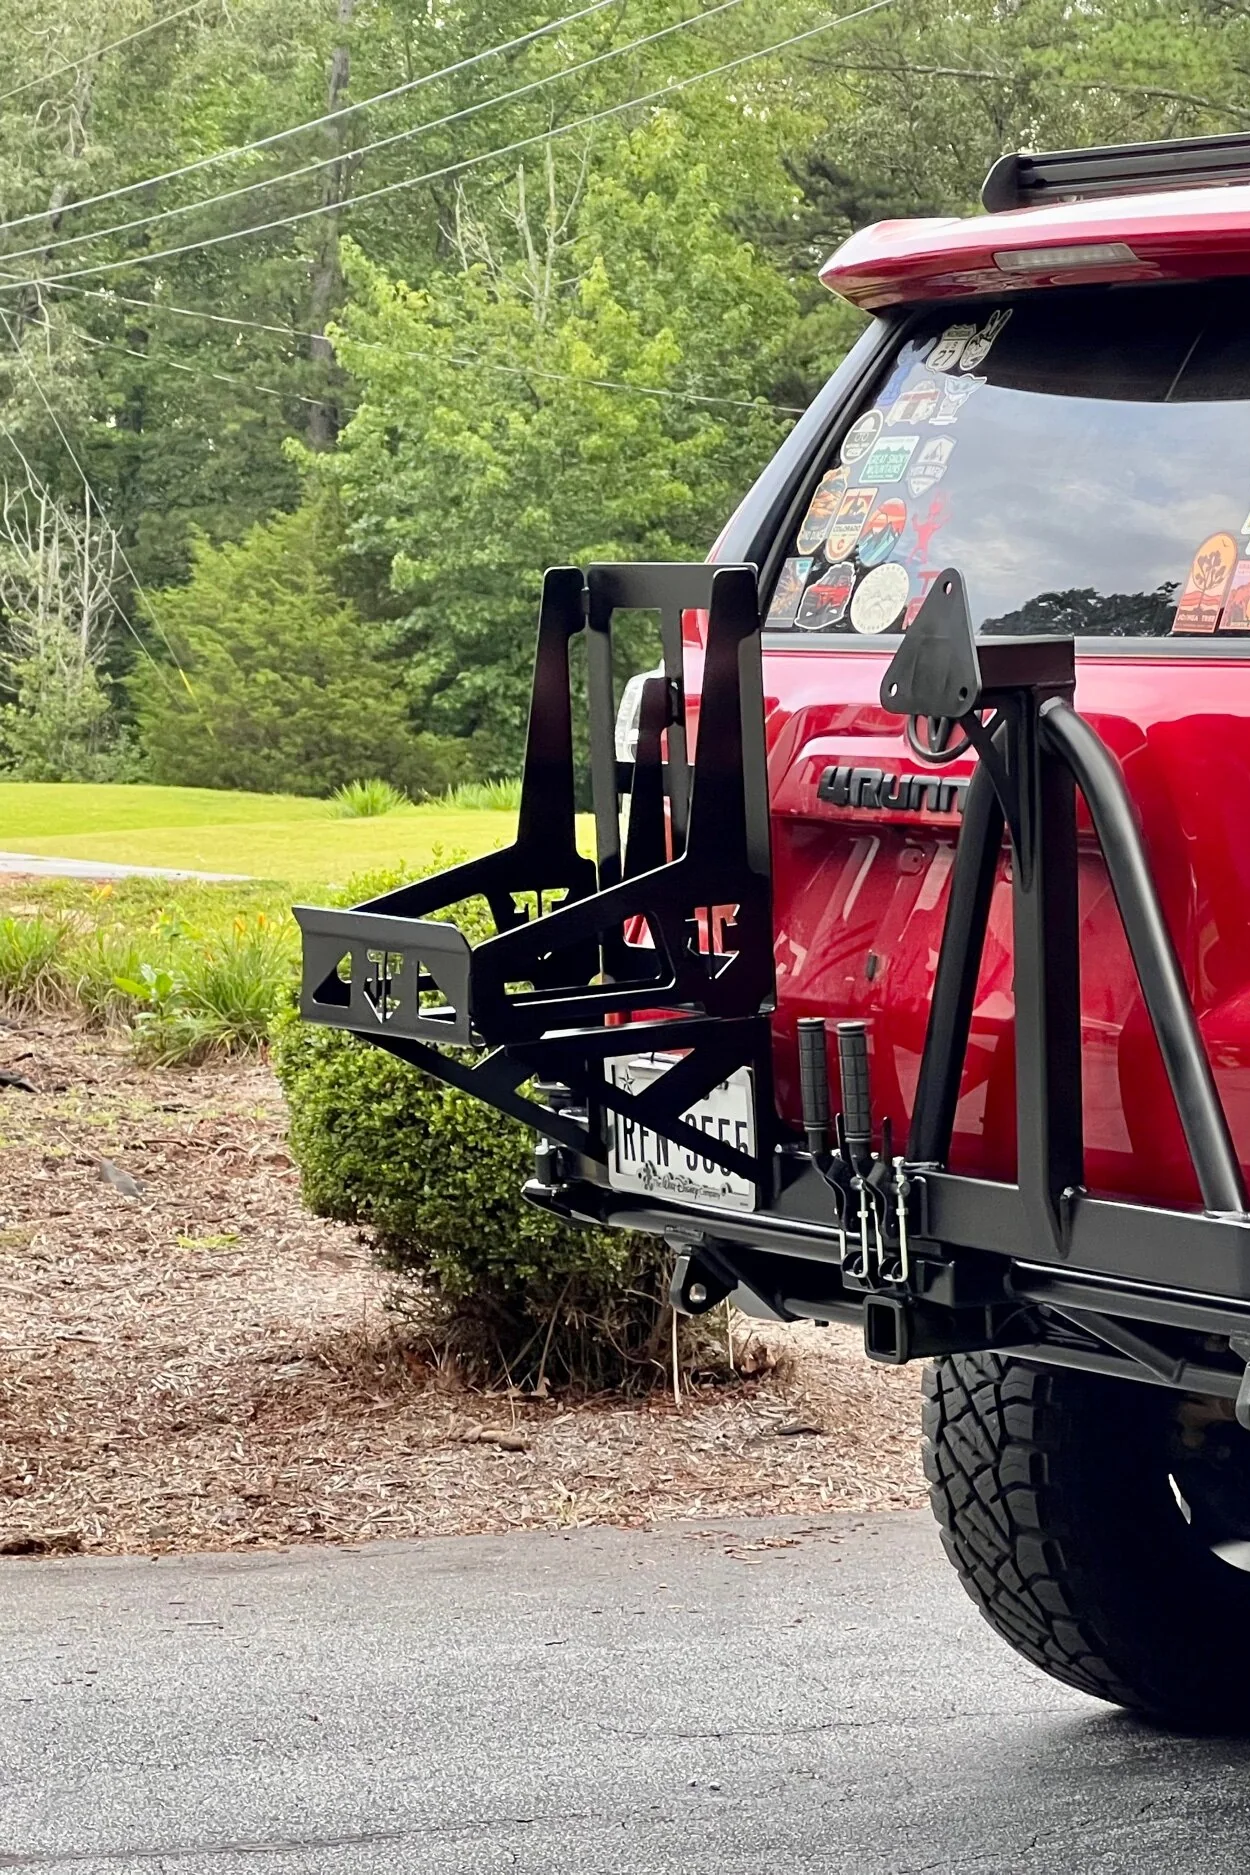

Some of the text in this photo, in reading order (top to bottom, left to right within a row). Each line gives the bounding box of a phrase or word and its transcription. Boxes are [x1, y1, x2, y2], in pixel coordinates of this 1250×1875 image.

[931, 349, 956, 367] 27
[832, 525, 861, 533] COLORADO
[817, 765, 972, 814] 4RUNN
[676, 1176, 701, 1200] Disney
